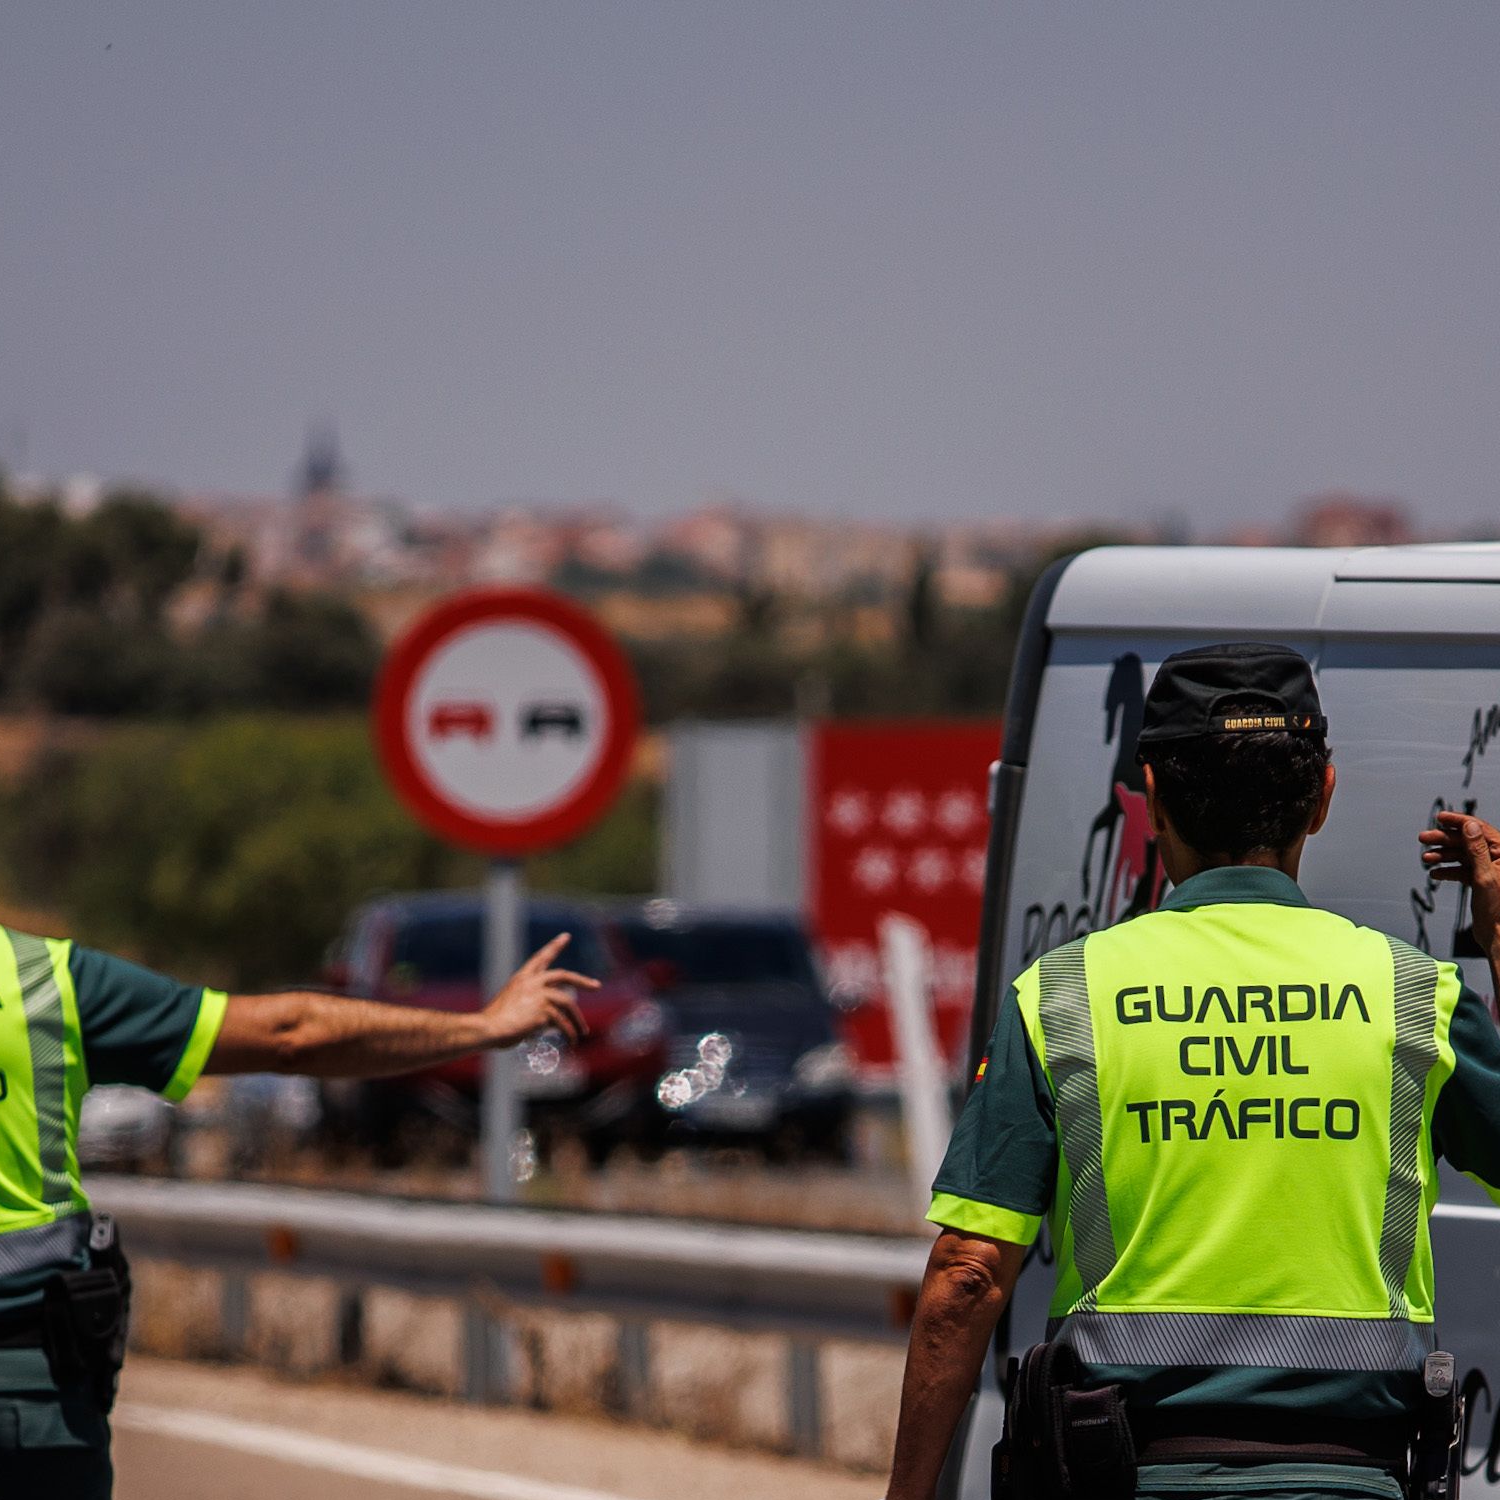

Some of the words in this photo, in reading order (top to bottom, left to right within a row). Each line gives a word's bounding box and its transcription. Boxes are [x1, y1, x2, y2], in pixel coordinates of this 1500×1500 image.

[1224, 718, 1263, 729] GUARDIA
[1264, 717, 1286, 727] CIVIL
[1115, 983, 1372, 1026] GUARDIA
[1179, 1034, 1310, 1077] CIVIL
[1126, 1088, 1361, 1144] TRÁFICO
